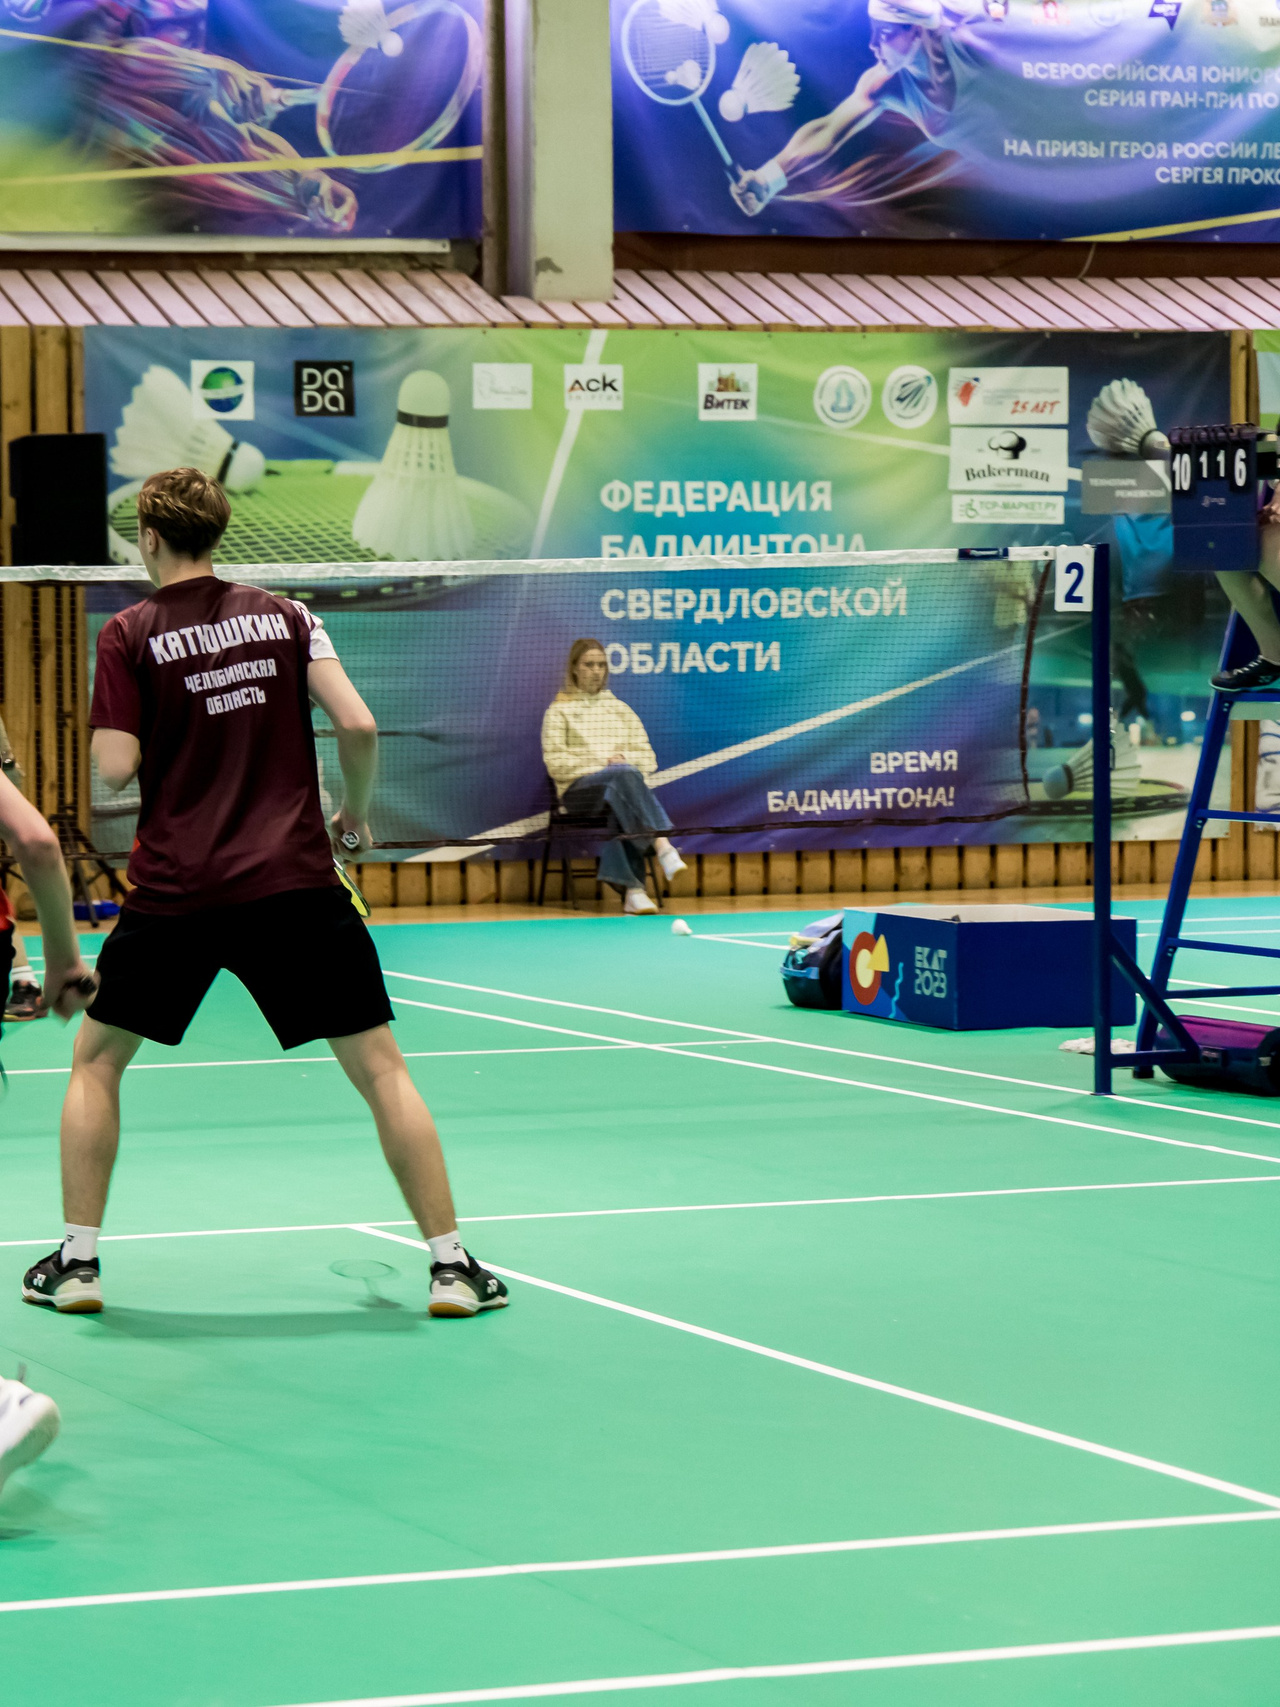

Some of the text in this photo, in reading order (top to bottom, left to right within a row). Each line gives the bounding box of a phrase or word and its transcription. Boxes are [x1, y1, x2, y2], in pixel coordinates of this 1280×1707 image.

[1022, 60, 1197, 83] ВСЕРОССИЙСКАЯ
[1084, 89, 1146, 107] СЕРИЯ
[1150, 90, 1243, 109] ГРАН-ПРИ
[1004, 139, 1033, 156] НА
[1036, 139, 1105, 158] ПРИЗЫ
[1110, 141, 1168, 159] ГЕРОЯ
[1172, 142, 1258, 159] РОССИИ
[1155, 166, 1223, 184] СЕРГЕЯ
[965, 464, 1050, 482] Bakerman
[1172, 448, 1247, 491] 10 1 1 6
[600, 480, 832, 517] ФЕДЕРАЦИЯ
[1064, 562, 1084, 603] 2
[600, 578, 907, 624] СВЕРДЛОВСКОЙ
[148, 613, 291, 665] КАТЮШКИН
[605, 641, 781, 674] ОБЛАСТИ
[184, 658, 277, 693] ЧЕЛЯБИНСКАЯ
[206, 686, 266, 715] ОБЛАСТЬ
[870, 750, 958, 774] ВРЕМЯ
[767, 786, 955, 815] БАДМИНТОНА!
